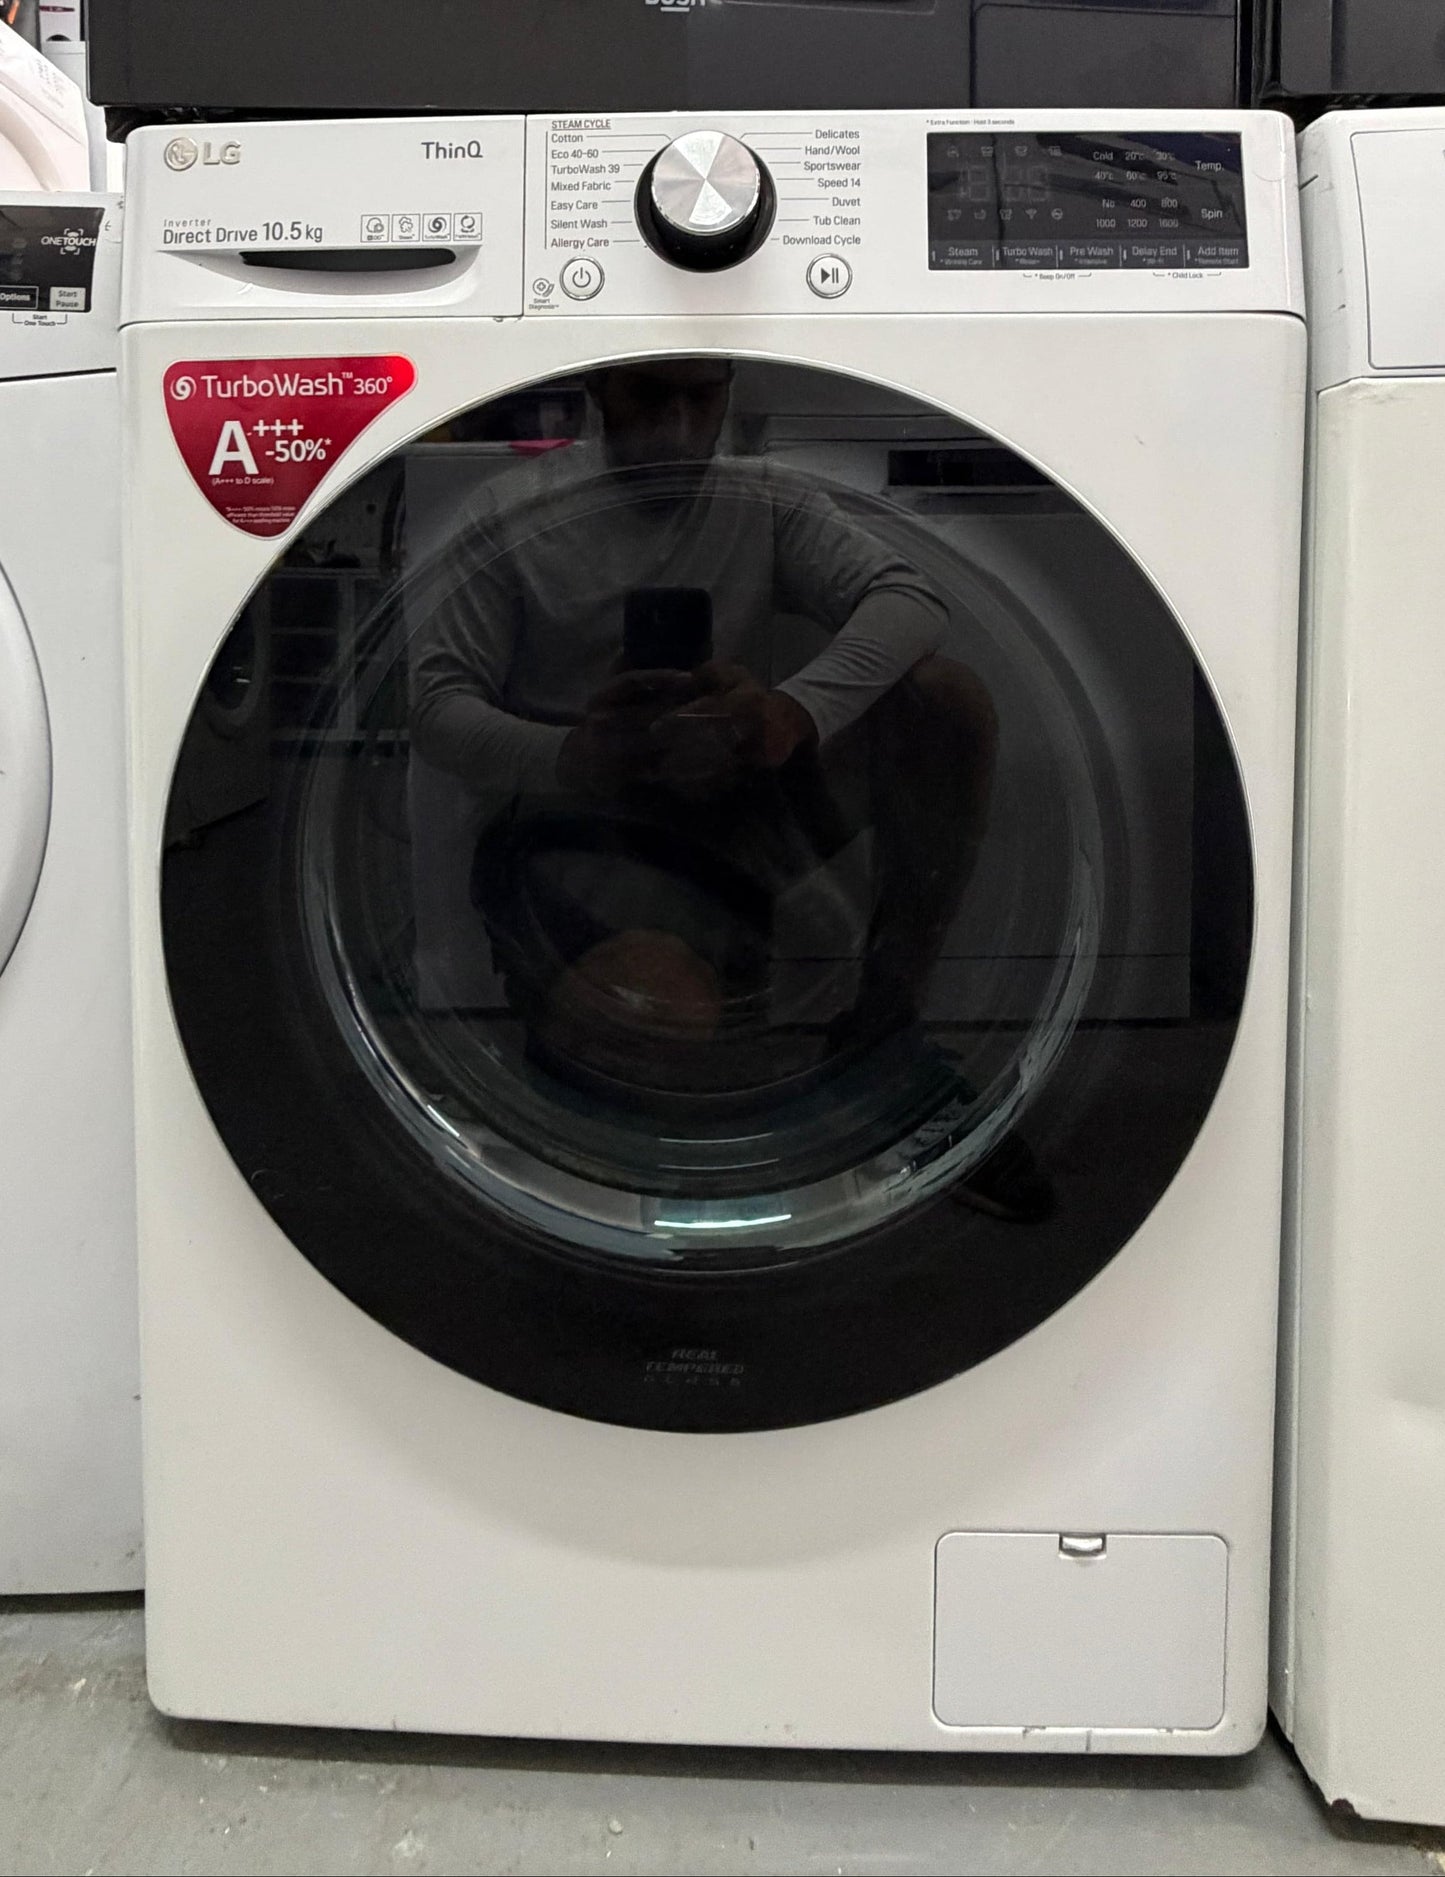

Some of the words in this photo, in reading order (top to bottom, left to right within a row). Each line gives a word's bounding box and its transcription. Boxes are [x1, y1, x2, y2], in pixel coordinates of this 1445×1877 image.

[551, 120, 582, 129] STEAM
[584, 119, 611, 129] CYCLE
[551, 133, 583, 143] Cotton
[815, 129, 860, 139] Delicates
[203, 141, 242, 165] LG
[421, 140, 483, 159] ThinQ
[551, 150, 569, 159] Eco
[571, 149, 599, 159] 40-60
[805, 145, 860, 155] Hand/Wool
[1093, 151, 1114, 161] Cold
[551, 164, 606, 174] TurboWash
[608, 163, 620, 173] 39
[804, 161, 861, 172] Sportswear
[1195, 160, 1225, 172] Temp.
[550, 181, 579, 191] Mixed
[581, 180, 611, 191] Fabric
[817, 178, 848, 189] Speed
[850, 178, 861, 187] 14
[550, 201, 574, 211] Easy
[576, 200, 598, 210] Care
[832, 196, 861, 206] Duvet
[1102, 199, 1115, 209] No
[1130, 199, 1146, 208] 400
[1161, 198, 1178, 208] 800
[1201, 208, 1223, 220] Spin
[163, 218, 211, 228] Inverter
[550, 219, 578, 229] Silent
[580, 219, 608, 228] Wash
[813, 215, 831, 225] Tub
[834, 215, 861, 225] Clean
[1096, 218, 1116, 228] 1000
[1127, 218, 1148, 228] 1200
[163, 229, 211, 244] Direct
[216, 228, 258, 243] Drive
[262, 221, 302, 241] 10.5
[305, 224, 323, 243] kg
[550, 238, 585, 249] Allergy
[587, 237, 609, 247] Care
[783, 235, 831, 245] Download
[834, 235, 861, 246] Cycle
[948, 246, 979, 256] Steam
[1002, 246, 1027, 256] Turbo
[1028, 246, 1053, 256] Wash
[1069, 246, 1085, 256] Pre
[1087, 246, 1114, 256] Wash
[1131, 246, 1157, 257] Delay
[1160, 246, 1177, 256] End
[1197, 246, 1216, 256] Add
[1218, 246, 1239, 256] Item
[0, 293, 31, 302] Options
[58, 290, 78, 298] Start
[56, 300, 79, 308] Pause
[354, 375, 393, 395] 360°
[244, 476, 251, 485] D
